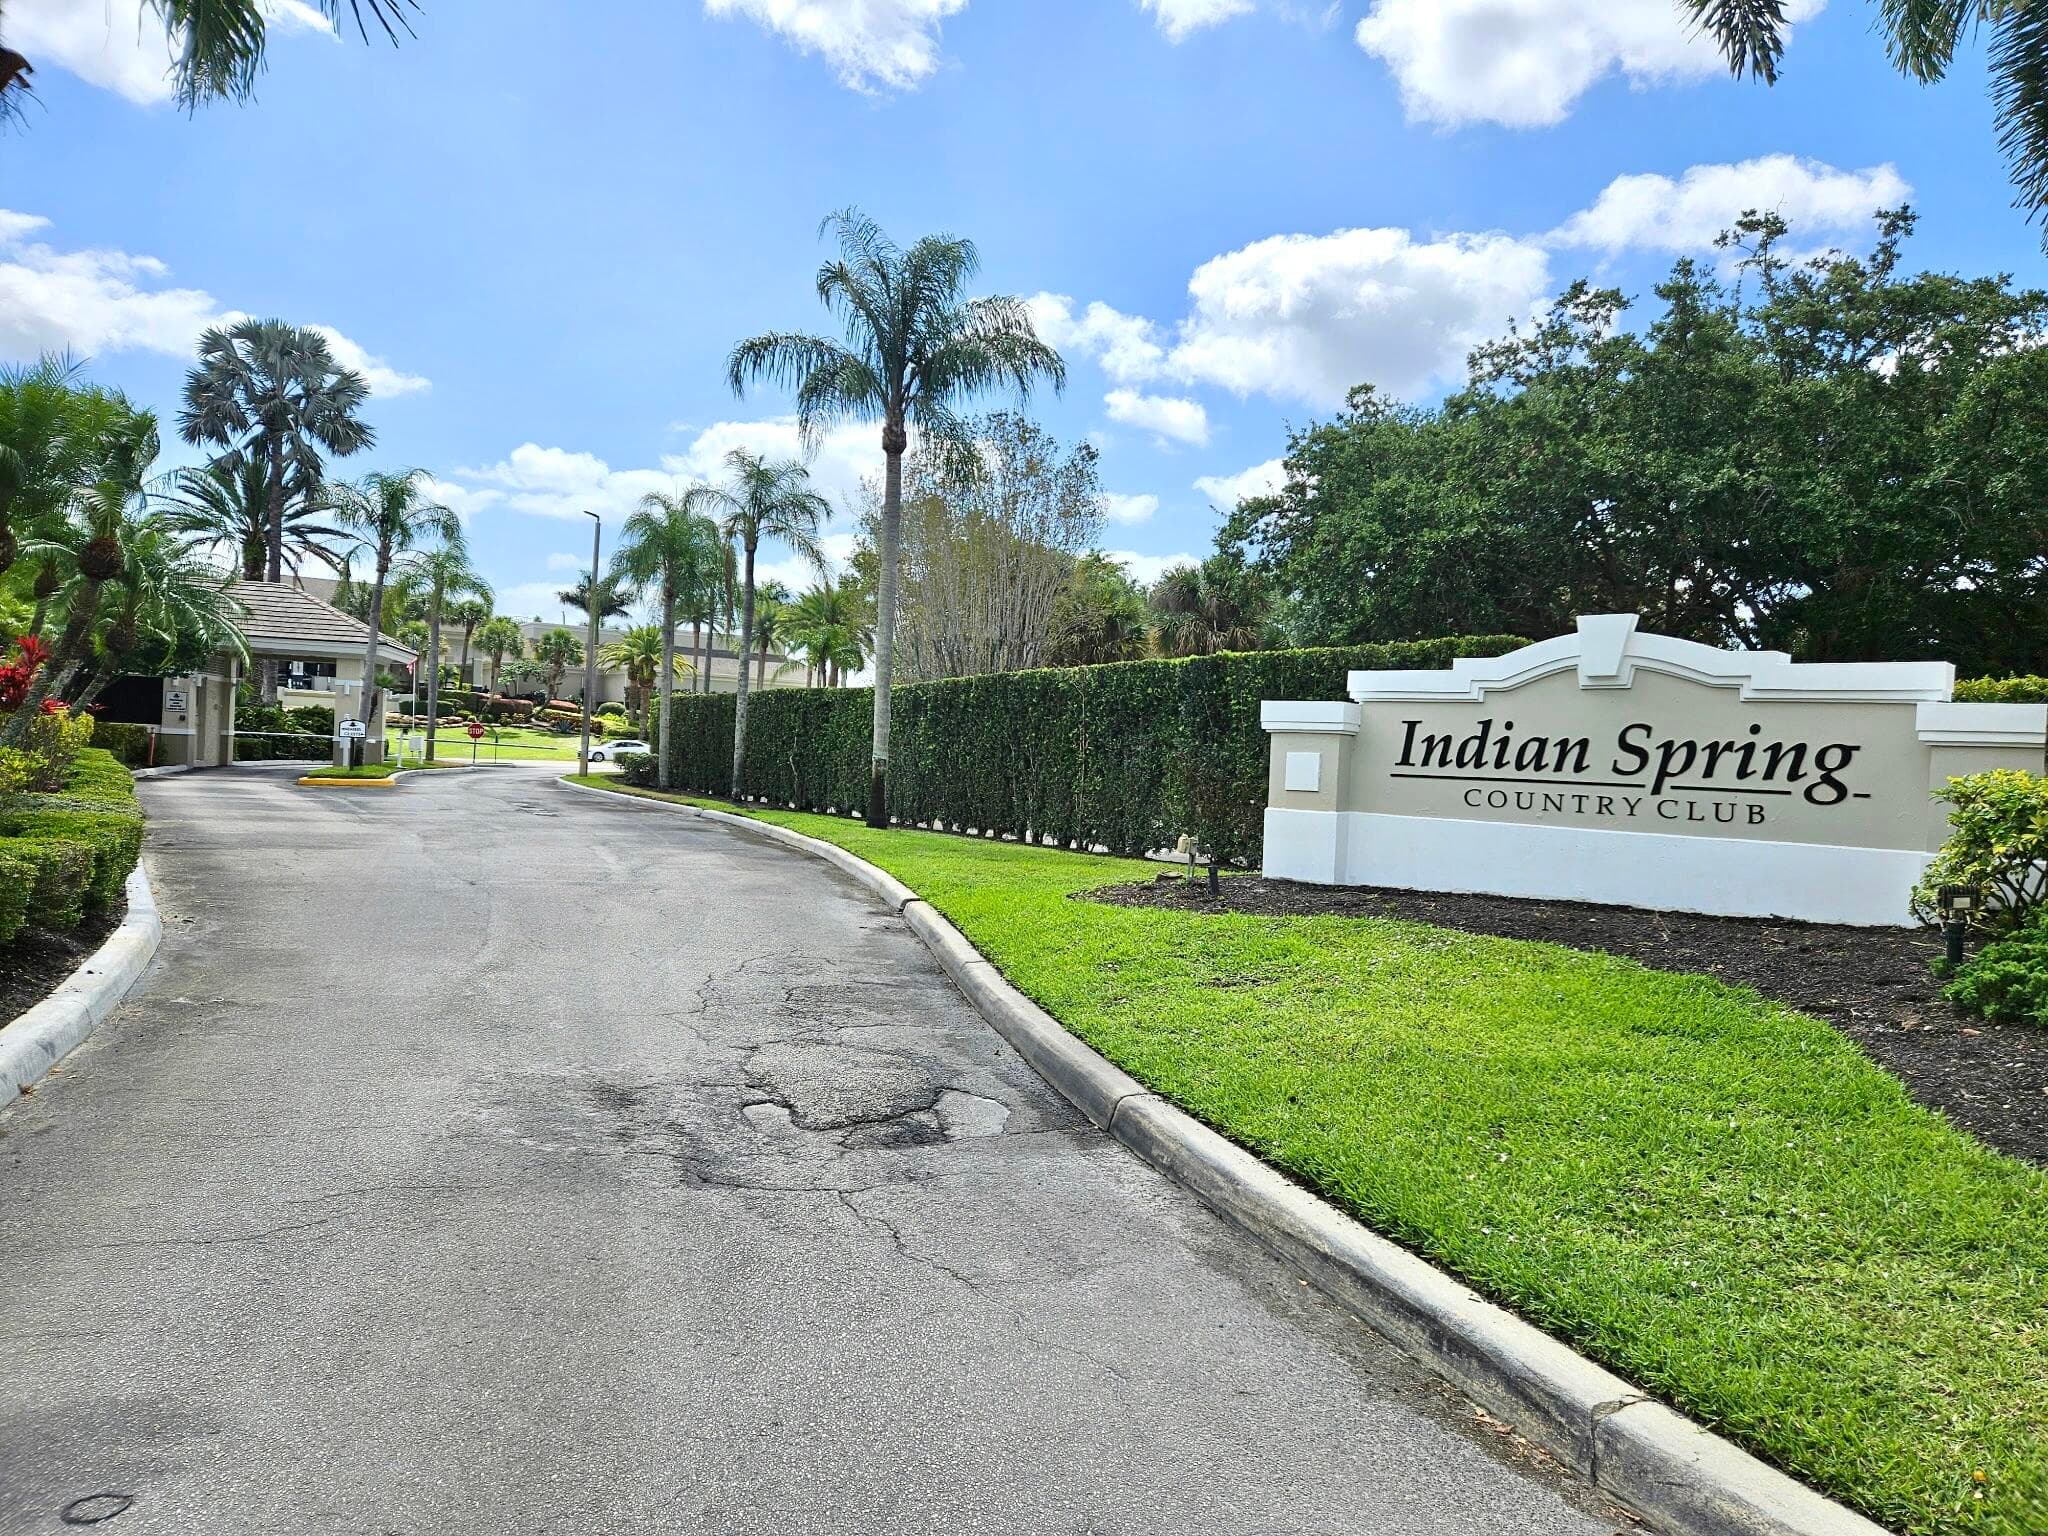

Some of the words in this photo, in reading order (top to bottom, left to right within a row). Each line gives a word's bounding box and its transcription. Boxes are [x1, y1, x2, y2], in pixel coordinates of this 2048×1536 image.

[1394, 718, 1591, 774] Indian
[1611, 723, 1862, 806] Spring
[1463, 788, 1643, 817] COUNTRY
[1656, 799, 1766, 825] CLUB
